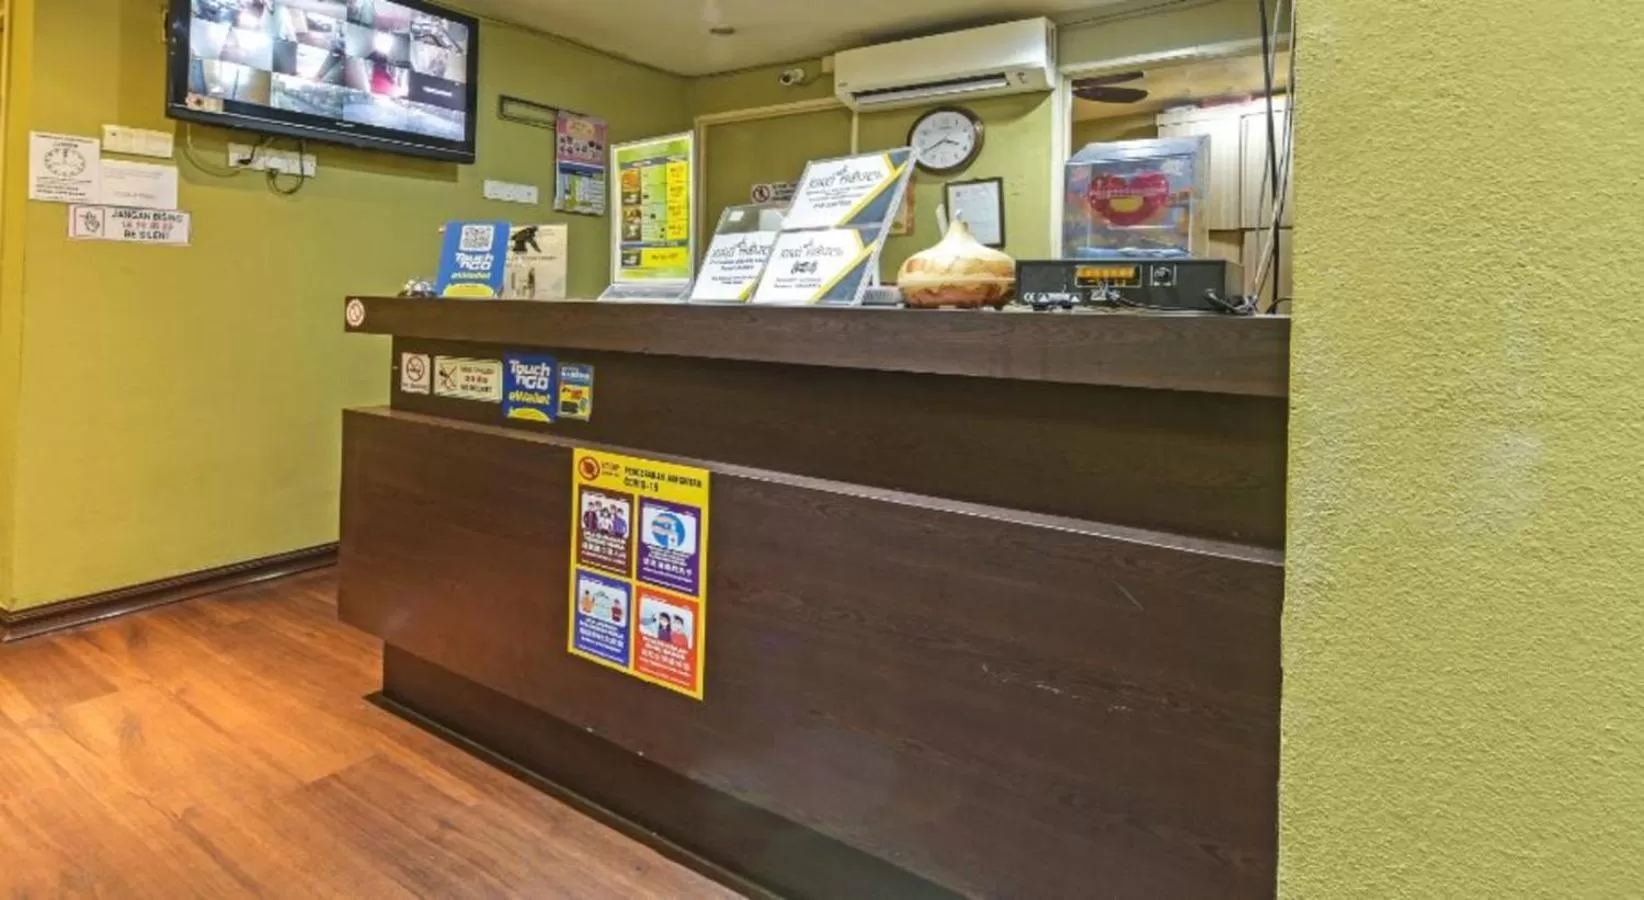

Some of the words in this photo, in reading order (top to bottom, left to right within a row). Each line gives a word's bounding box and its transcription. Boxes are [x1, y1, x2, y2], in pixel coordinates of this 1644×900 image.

[111, 209, 151, 221] JANGAN
[454, 251, 495, 264] Touch
[509, 359, 551, 377] Touch
